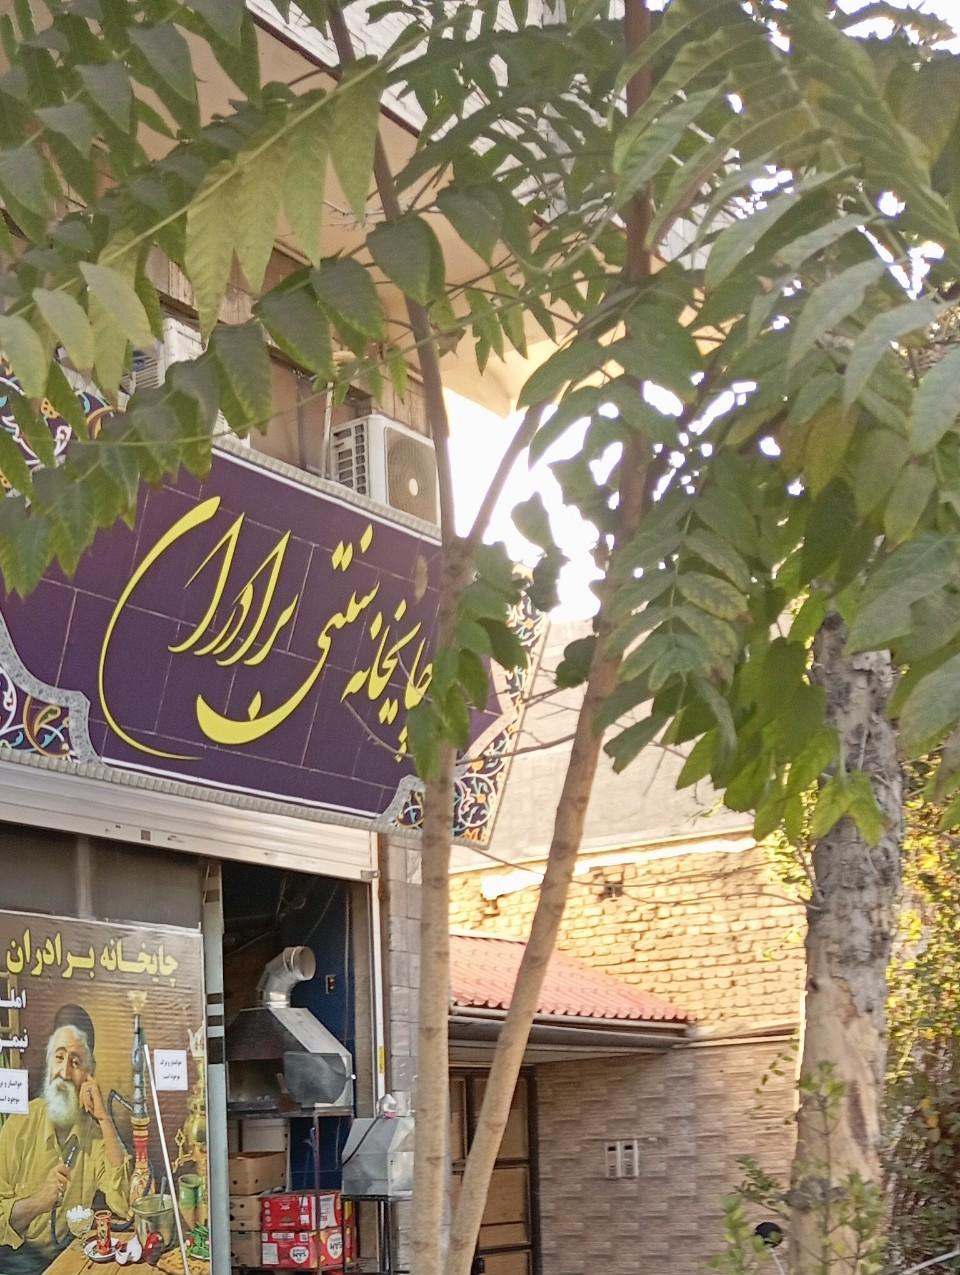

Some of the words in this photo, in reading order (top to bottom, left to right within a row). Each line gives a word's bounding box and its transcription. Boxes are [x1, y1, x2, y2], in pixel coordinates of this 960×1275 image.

[98, 495, 300, 761] برادران
[196, 524, 381, 746] سنتی
[6, 928, 95, 979] برادران
[100, 937, 179, 987] چایخانه
